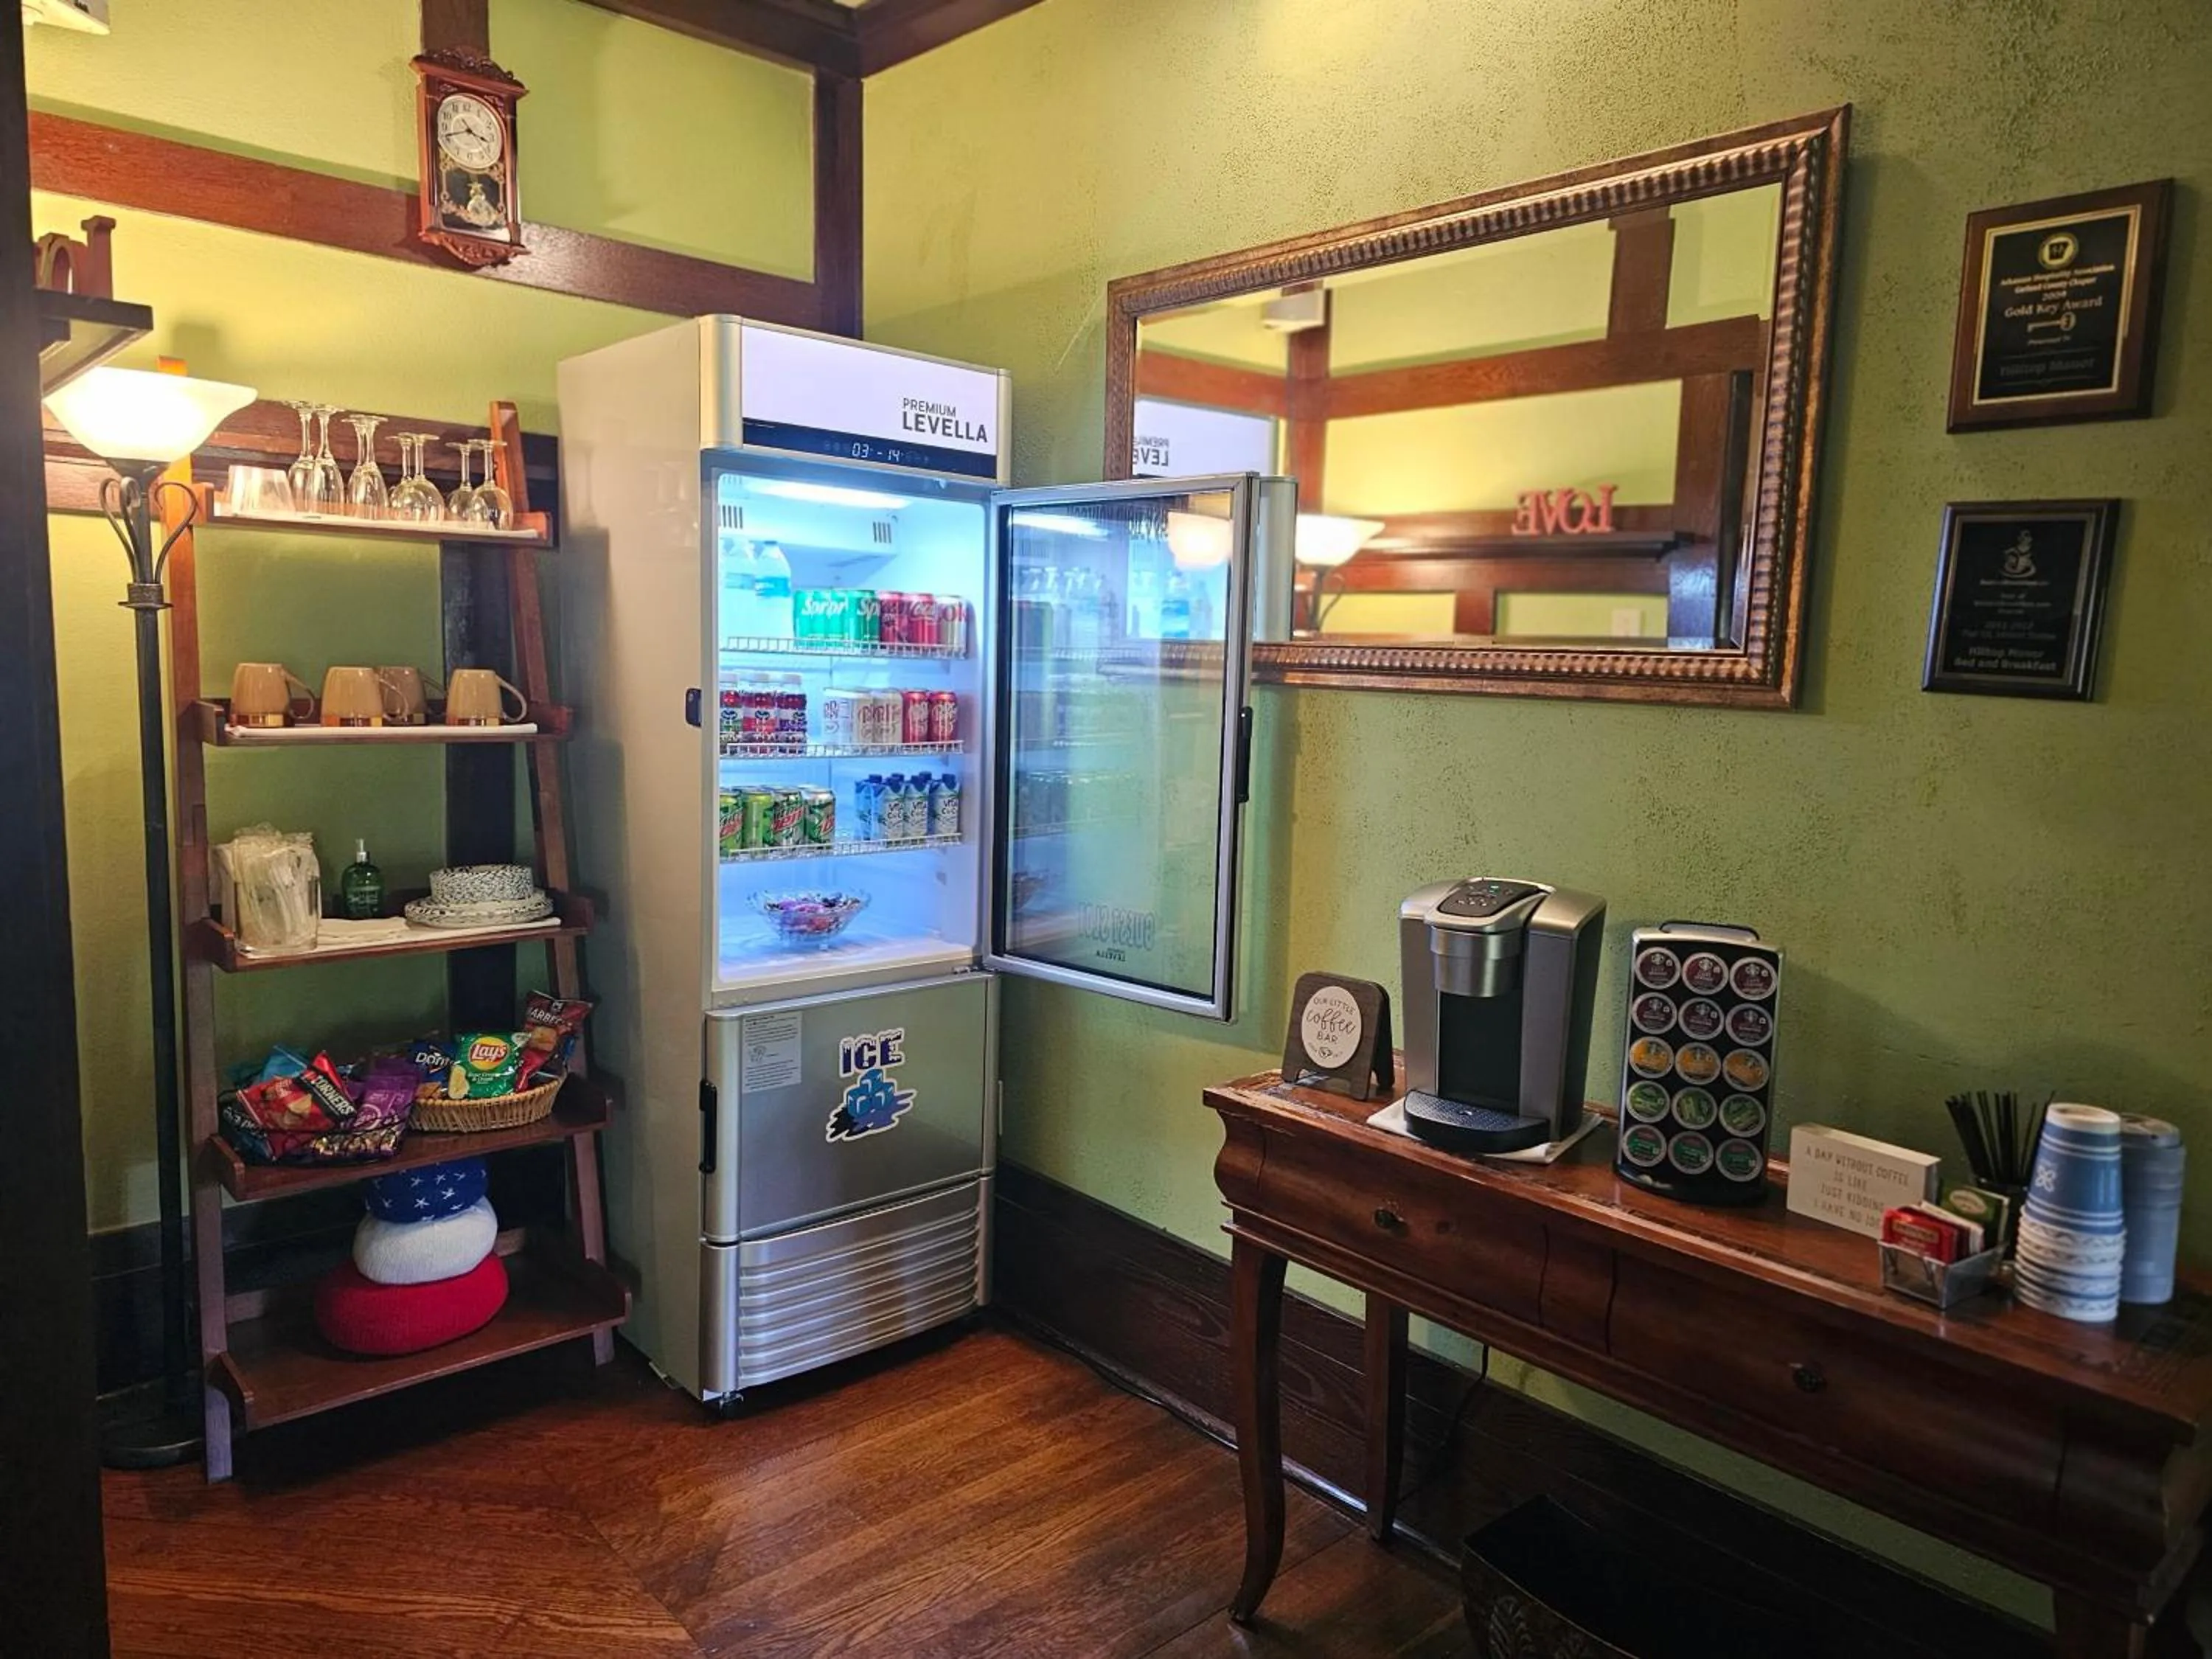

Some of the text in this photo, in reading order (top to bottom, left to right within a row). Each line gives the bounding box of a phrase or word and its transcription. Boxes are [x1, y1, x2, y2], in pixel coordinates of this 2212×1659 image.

[2003, 295, 2103, 319] Gold Key Award
[902, 397, 956, 417] PREMIUM
[902, 411, 988, 443] LEVELLA
[852, 442, 869, 458] 03
[1317, 1031, 1338, 1044] BAR
[841, 1030, 904, 1075] ICE
[1806, 1145, 1910, 1186] A DAY WITHOUT COFFEE
[1820, 1183, 1843, 1200] JUST
